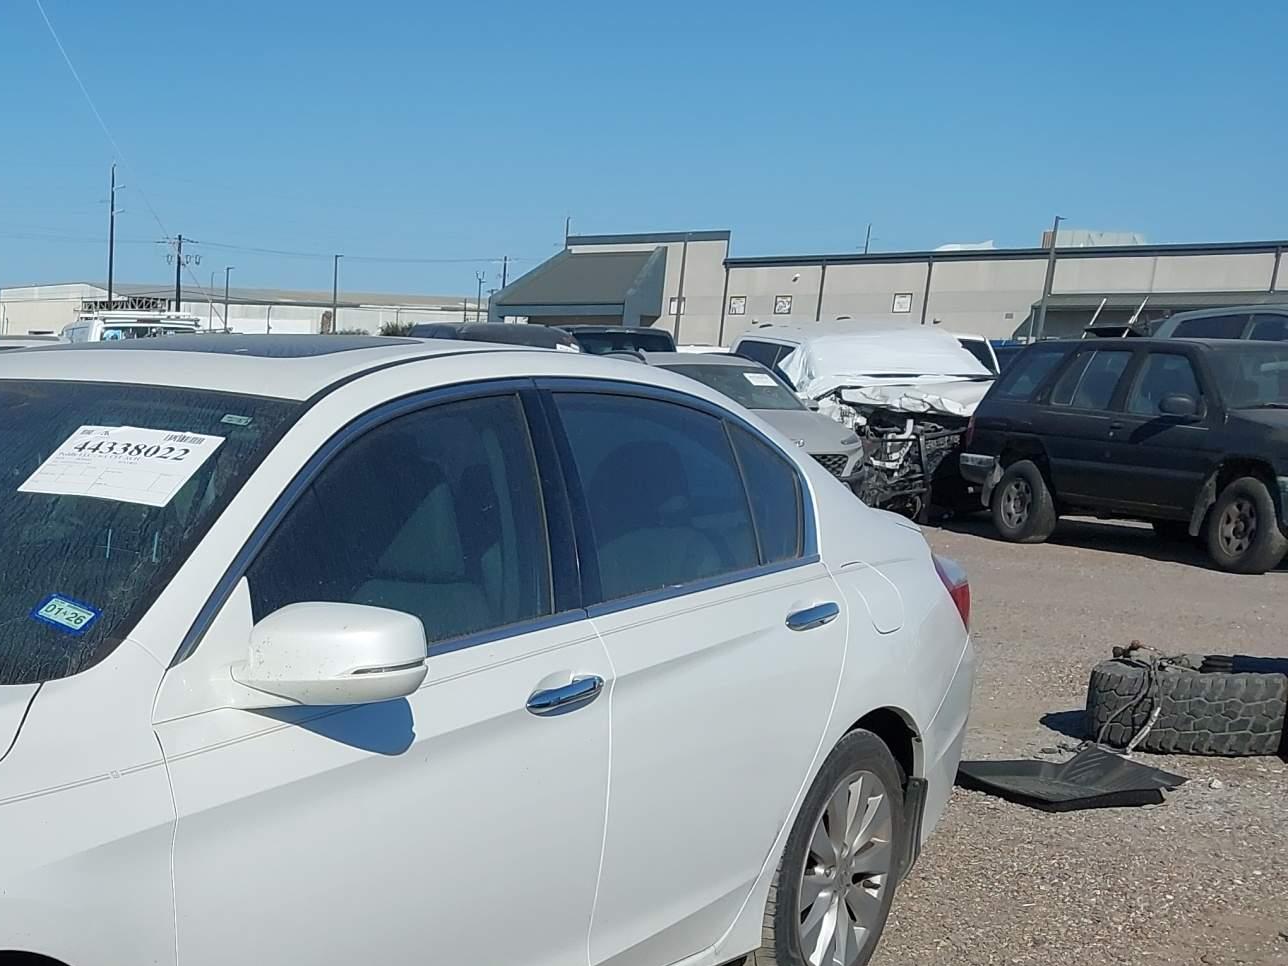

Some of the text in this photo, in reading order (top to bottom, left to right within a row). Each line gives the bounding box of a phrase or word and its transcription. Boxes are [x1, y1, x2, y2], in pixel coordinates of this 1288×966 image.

[73, 440, 191, 461] 44338022
[44, 604, 85, 624] 01 26
